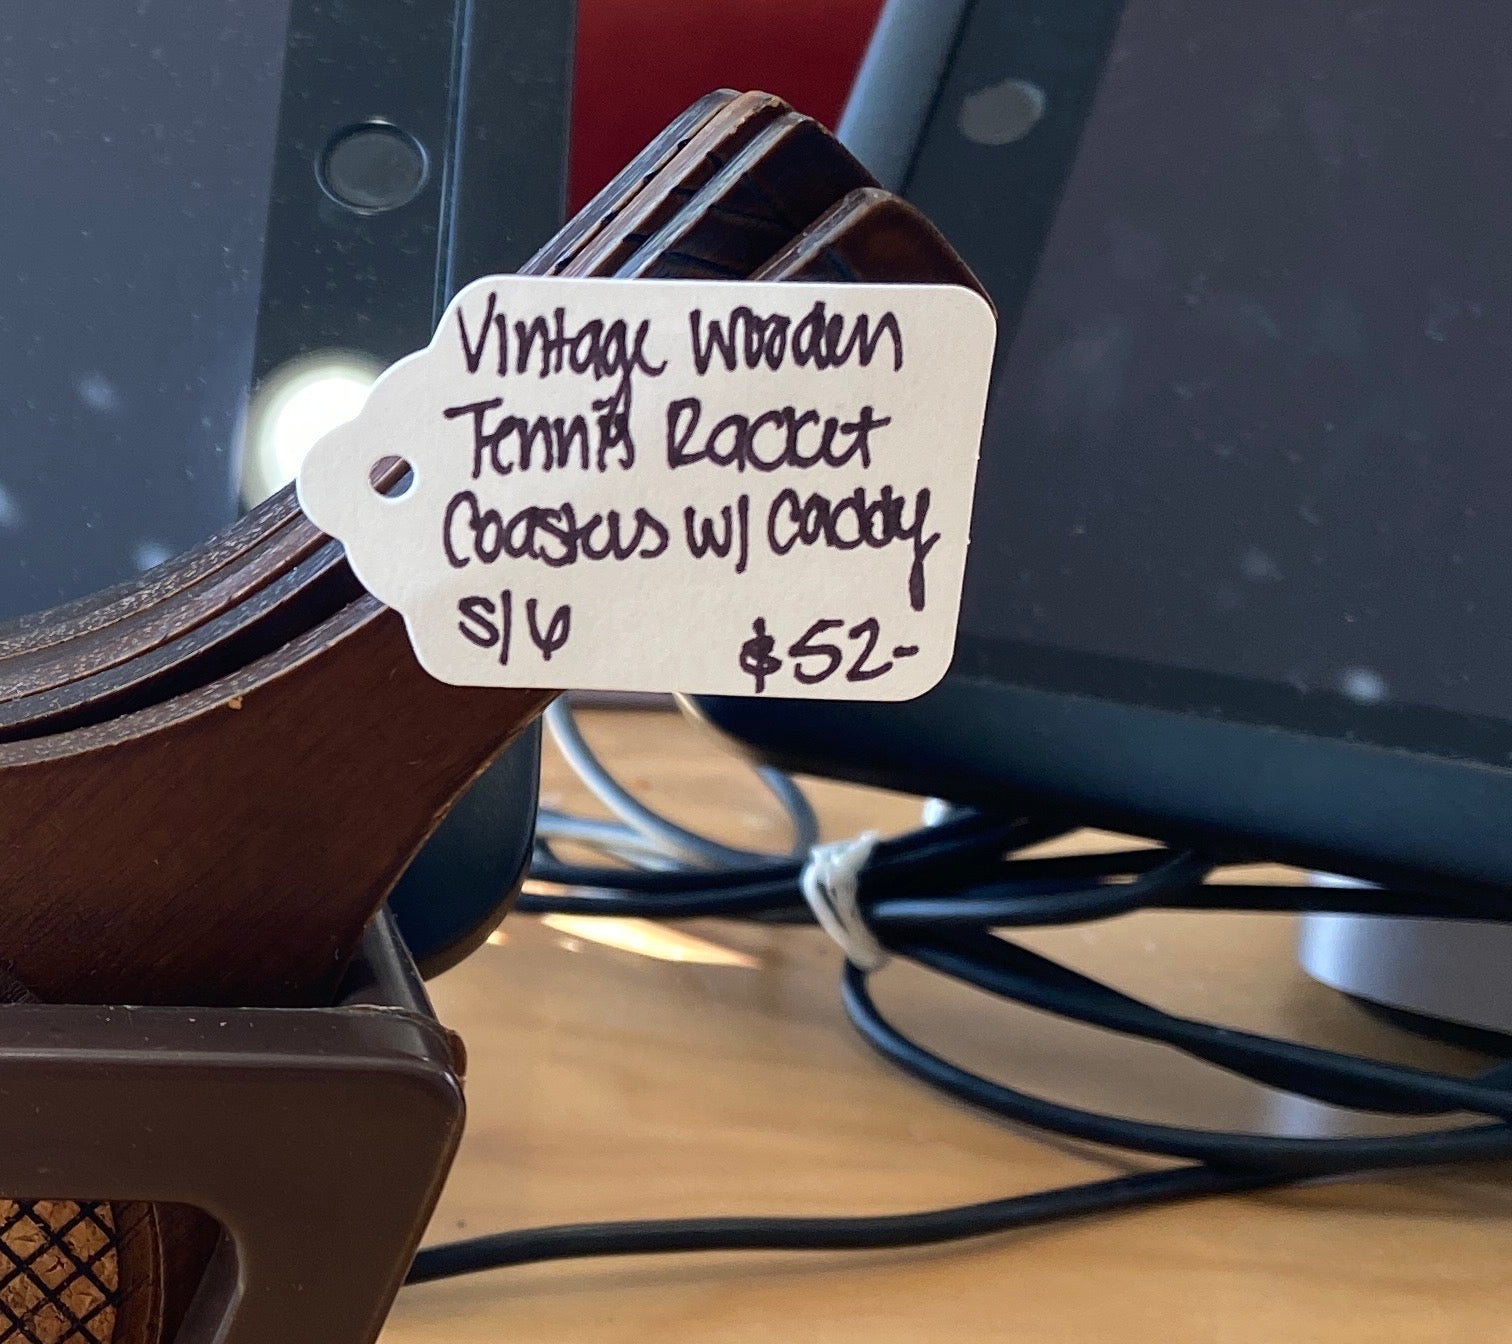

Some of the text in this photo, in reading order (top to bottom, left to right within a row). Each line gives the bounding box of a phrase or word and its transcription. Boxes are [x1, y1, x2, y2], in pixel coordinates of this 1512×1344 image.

[455, 291, 669, 404] Vintage
[443, 394, 892, 480] Tennis Racket
[443, 490, 670, 569] Coasters
